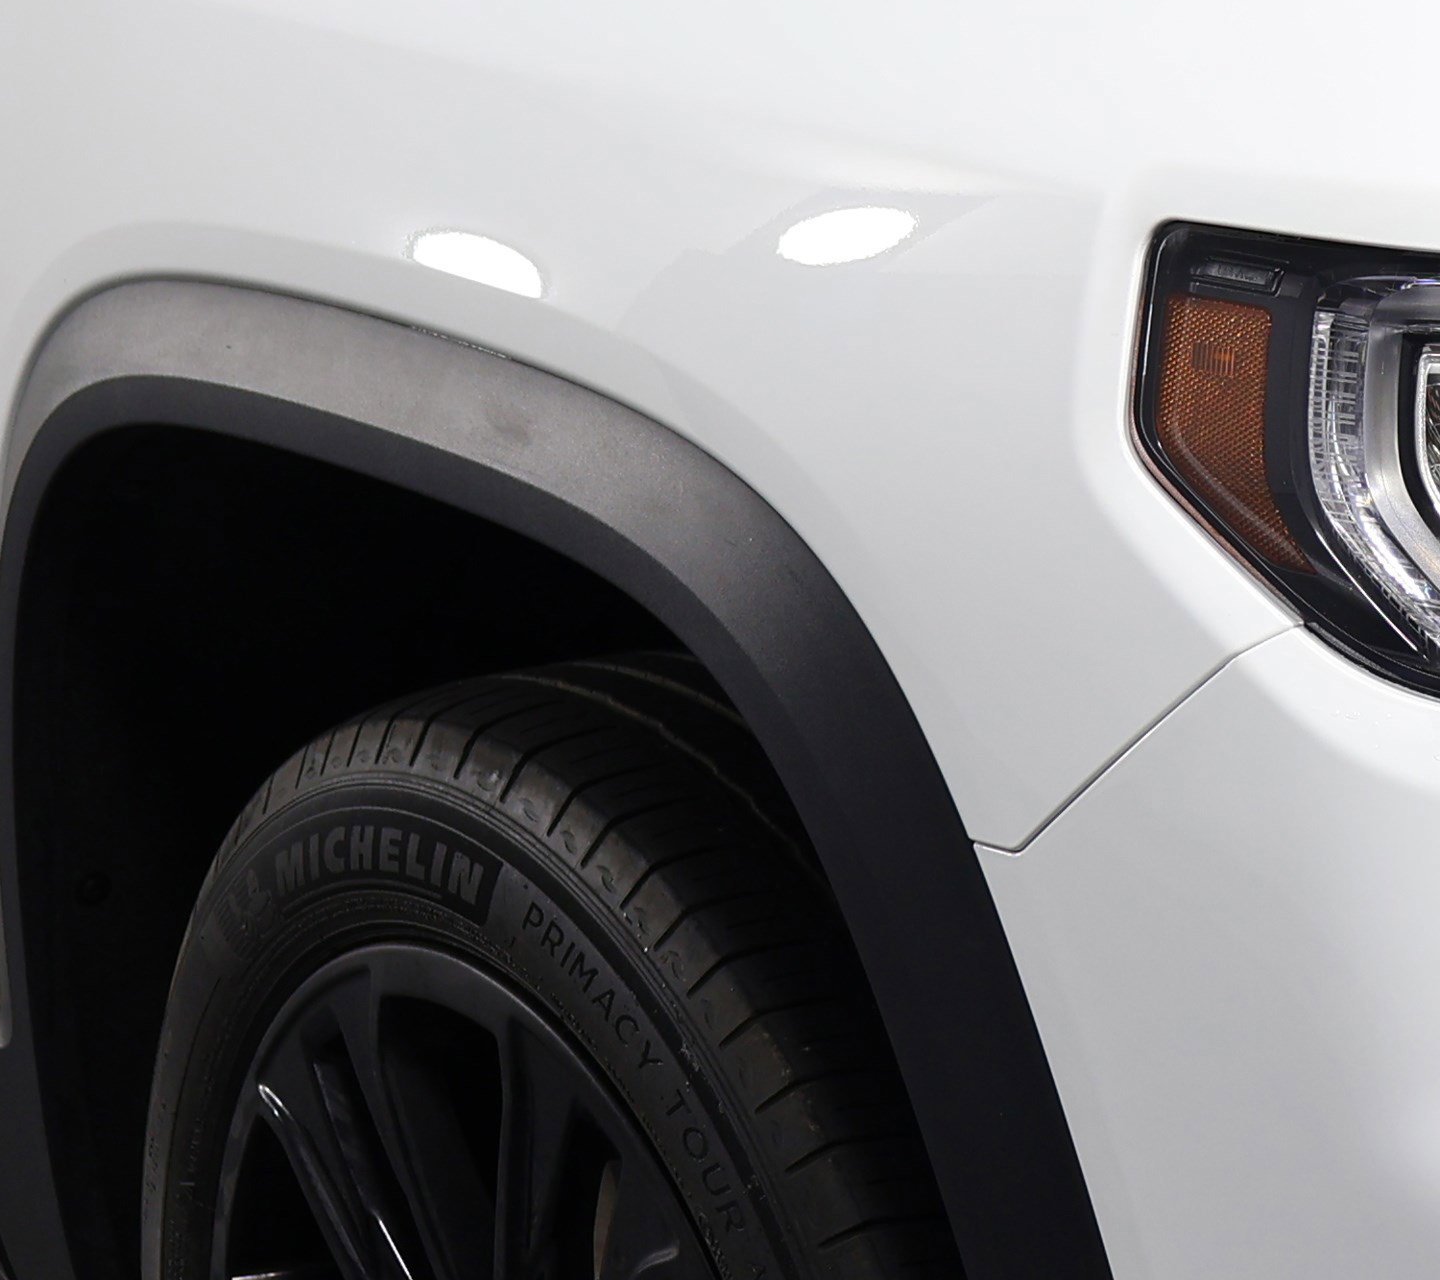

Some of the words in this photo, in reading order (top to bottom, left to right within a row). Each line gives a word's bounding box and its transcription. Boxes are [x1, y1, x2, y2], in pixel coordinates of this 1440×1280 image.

[275, 824, 484, 906] MICHELIN
[521, 901, 663, 1071] PRIMACY
[664, 1088, 747, 1234] TOUR
